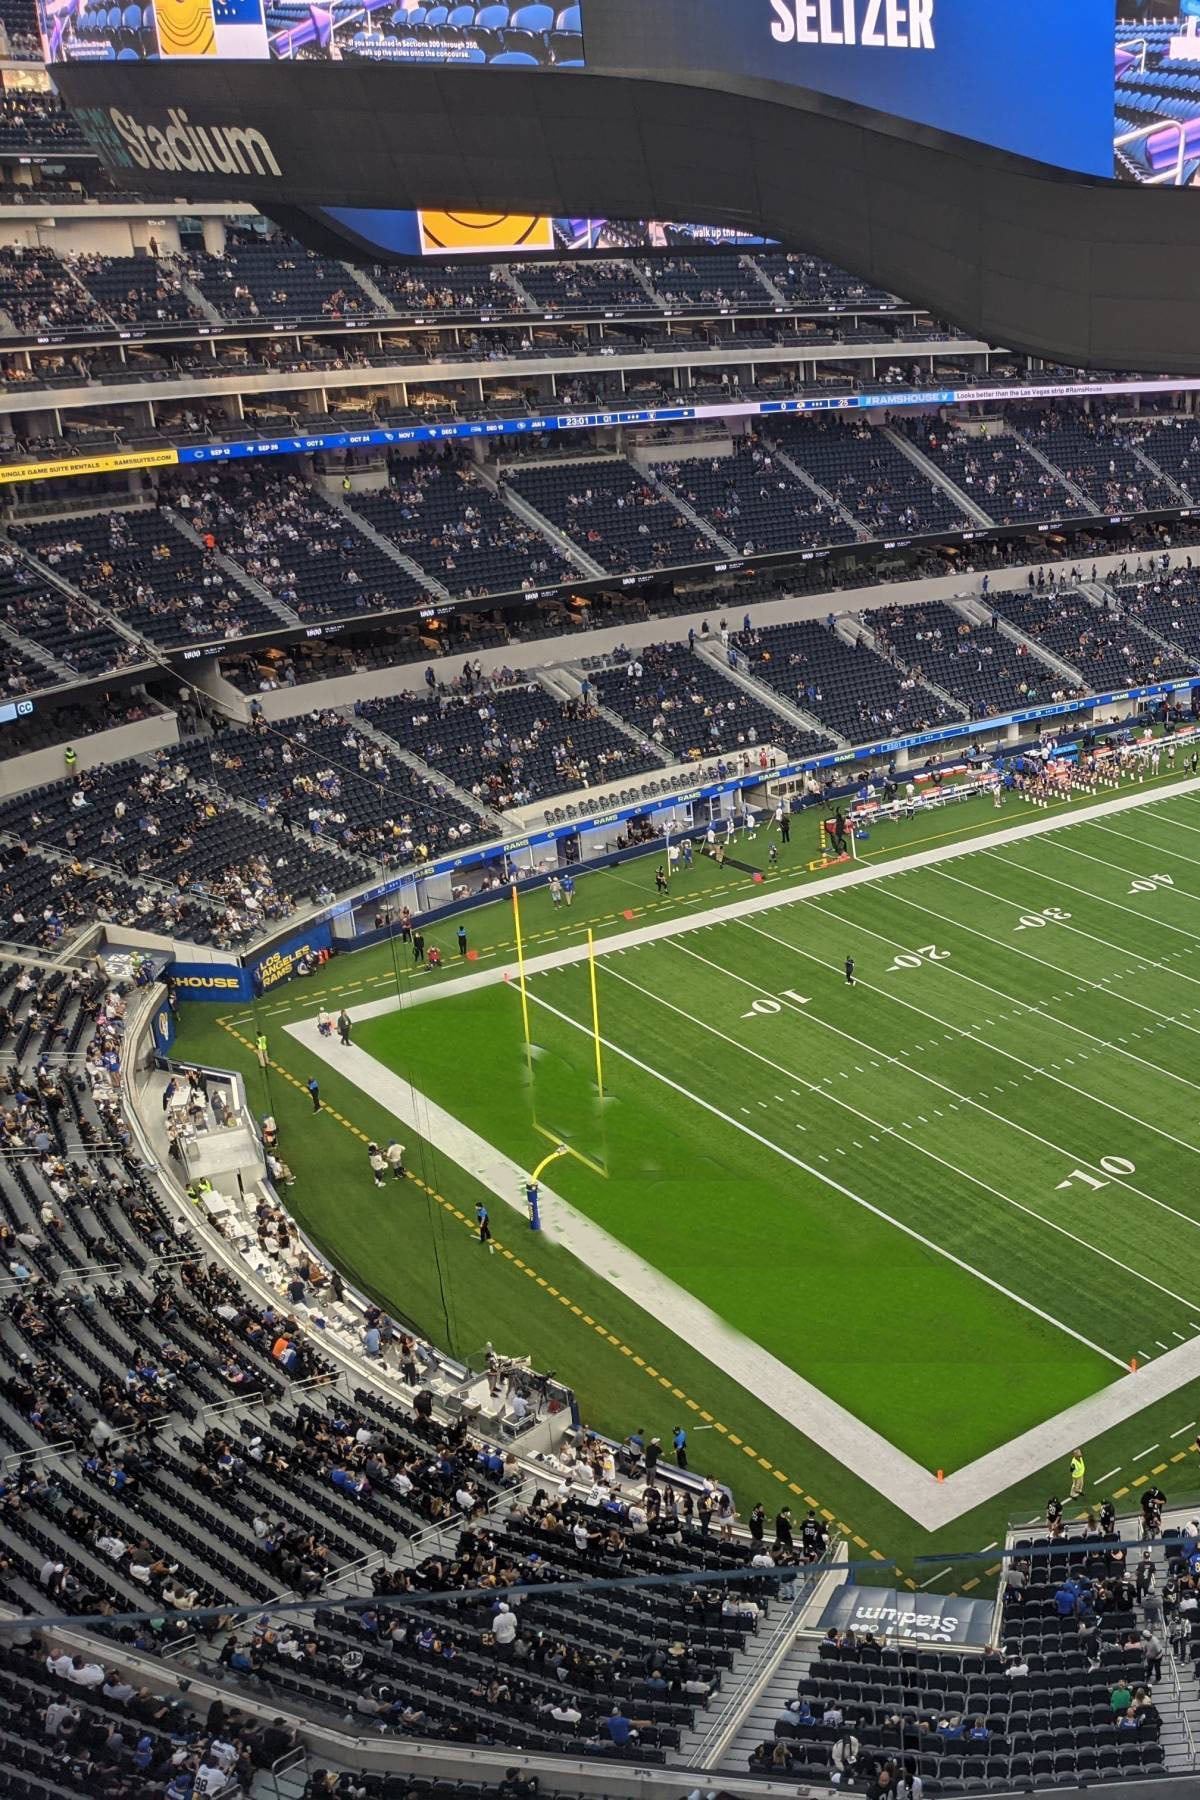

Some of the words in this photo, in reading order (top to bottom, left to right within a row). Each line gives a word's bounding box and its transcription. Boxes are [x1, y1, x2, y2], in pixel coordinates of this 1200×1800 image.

[110, 107, 283, 177] Stadium
[711, 228, 721, 239] up
[866, 392, 938, 406] #RAMSHOUSE
[1032, 388, 1050, 397] Vegas
[1051, 387, 1065, 396] strip
[566, 416, 589, 425] 23:01
[1, 470, 26, 479] SINGLE
[27, 468, 48, 476] GAME
[49, 465, 70, 474] SUITE
[70, 463, 100, 472] RENTALS
[18, 702, 33, 714] CC
[834, 752, 855, 763] RAMS
[758, 771, 780, 782] RAMS
[678, 791, 701, 803] RAMS
[593, 813, 619, 826] RAMS
[504, 838, 529, 853] RAMS
[260, 952, 281, 971] LOS
[262, 945, 310, 980] ANGELES
[892, 944, 952, 970] 20
[263, 965, 293, 988] RAMS
[750, 989, 813, 1016] 10
[1069, 1155, 1137, 1192] 10
[856, 1606, 959, 1633] Stadium
